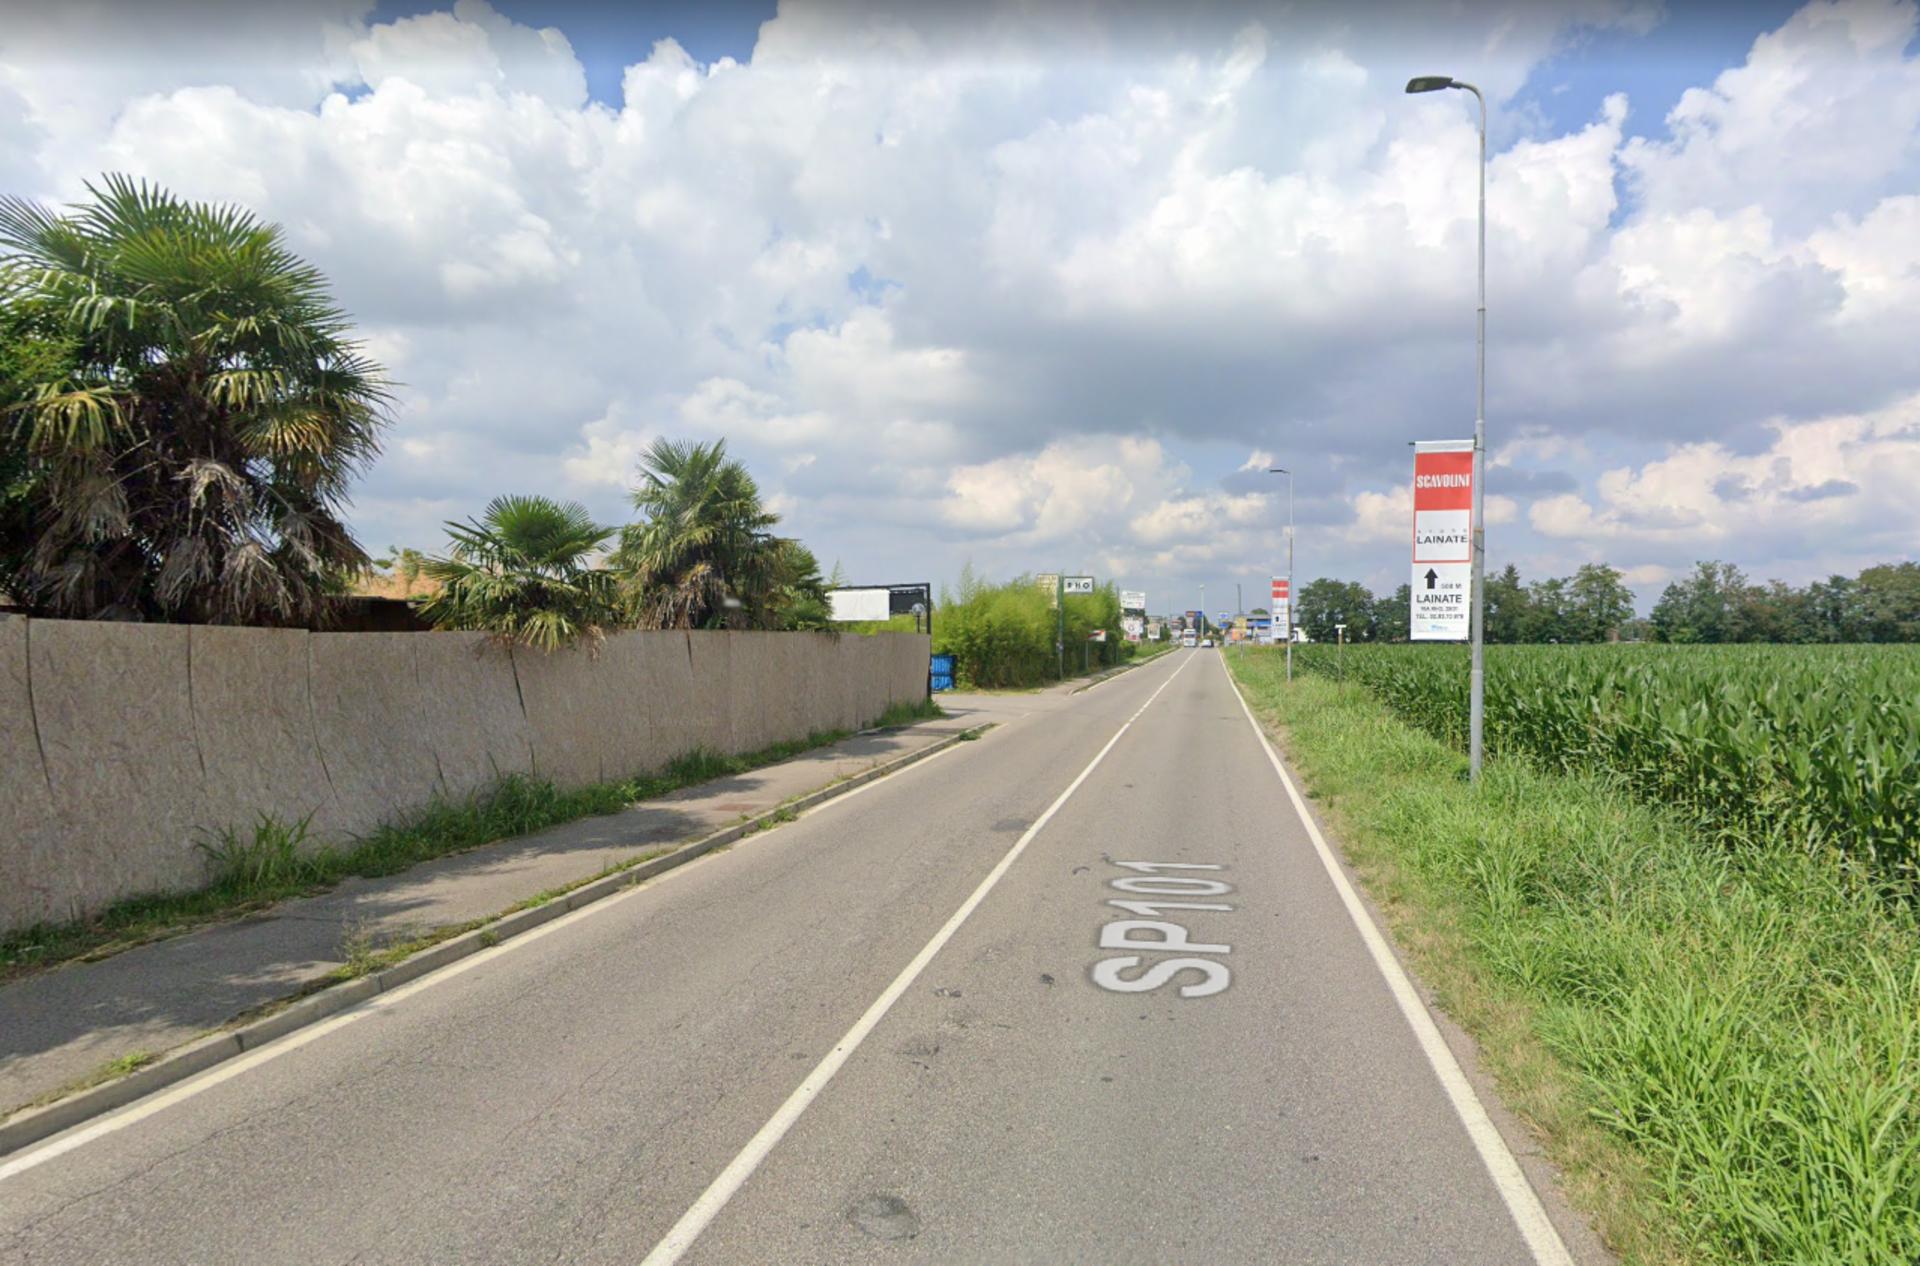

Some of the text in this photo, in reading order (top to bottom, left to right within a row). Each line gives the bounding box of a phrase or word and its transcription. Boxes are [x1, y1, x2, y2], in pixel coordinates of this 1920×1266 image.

[1416, 473, 1470, 488] SCAVOLINI
[1416, 535, 1469, 545] LAINATE
[1416, 594, 1463, 604] LAINATE
